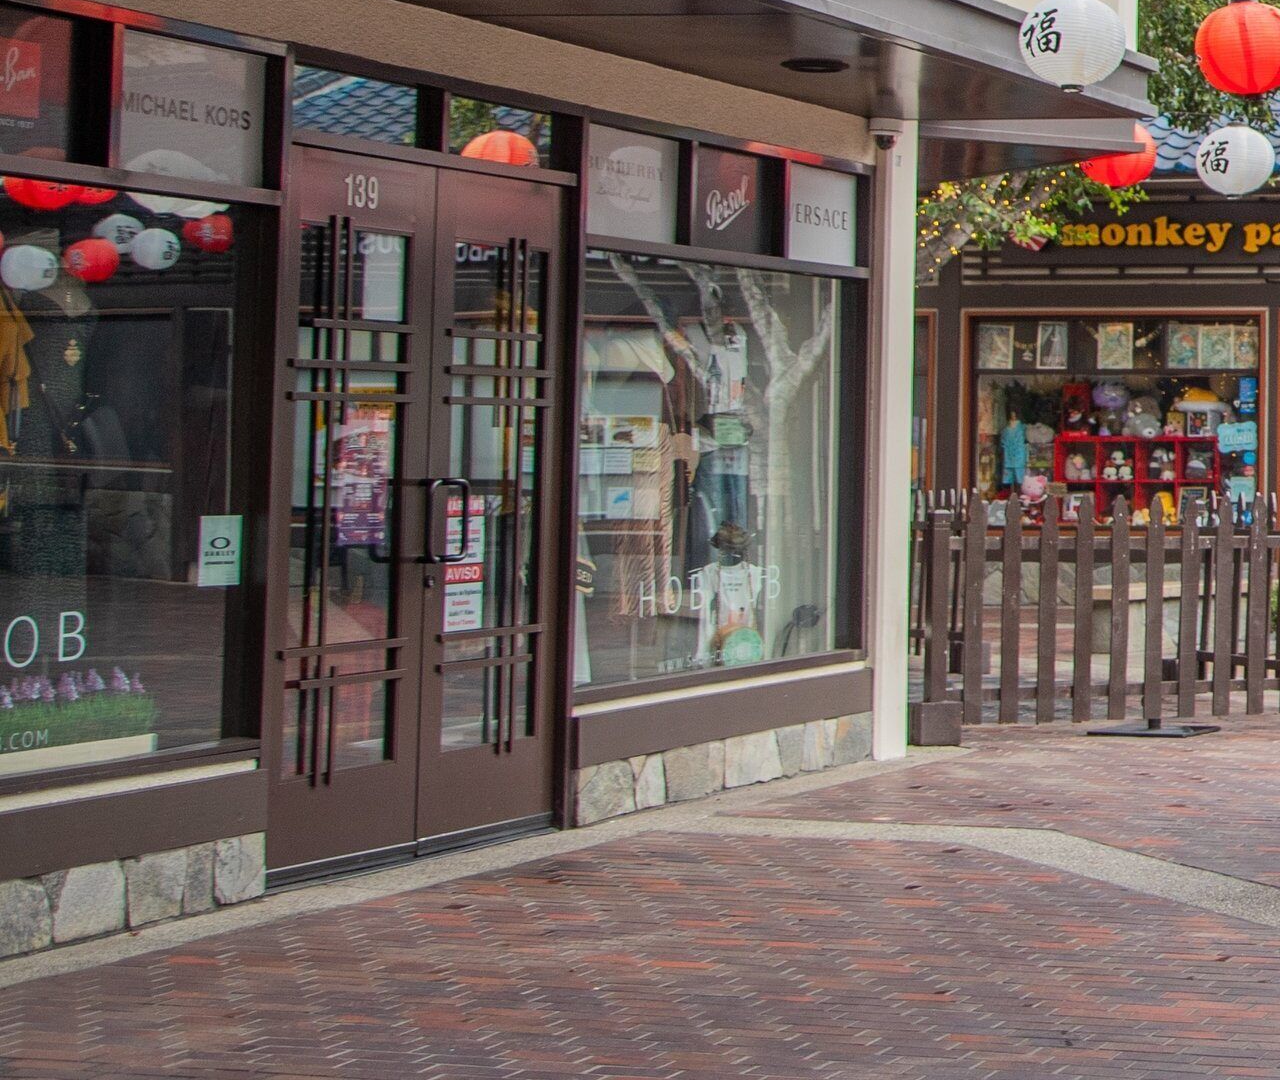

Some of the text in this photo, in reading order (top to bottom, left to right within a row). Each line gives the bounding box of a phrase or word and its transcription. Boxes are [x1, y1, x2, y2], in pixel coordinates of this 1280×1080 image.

[1022, 8, 1062, 59] 福
[122, 92, 251, 131] MICHAEL KORS
[1200, 140, 1230, 175] 福
[345, 173, 379, 209] 139
[706, 174, 750, 230] Persol
[1062, 216, 1232, 253] monkey
[446, 564, 481, 580] AVISO
